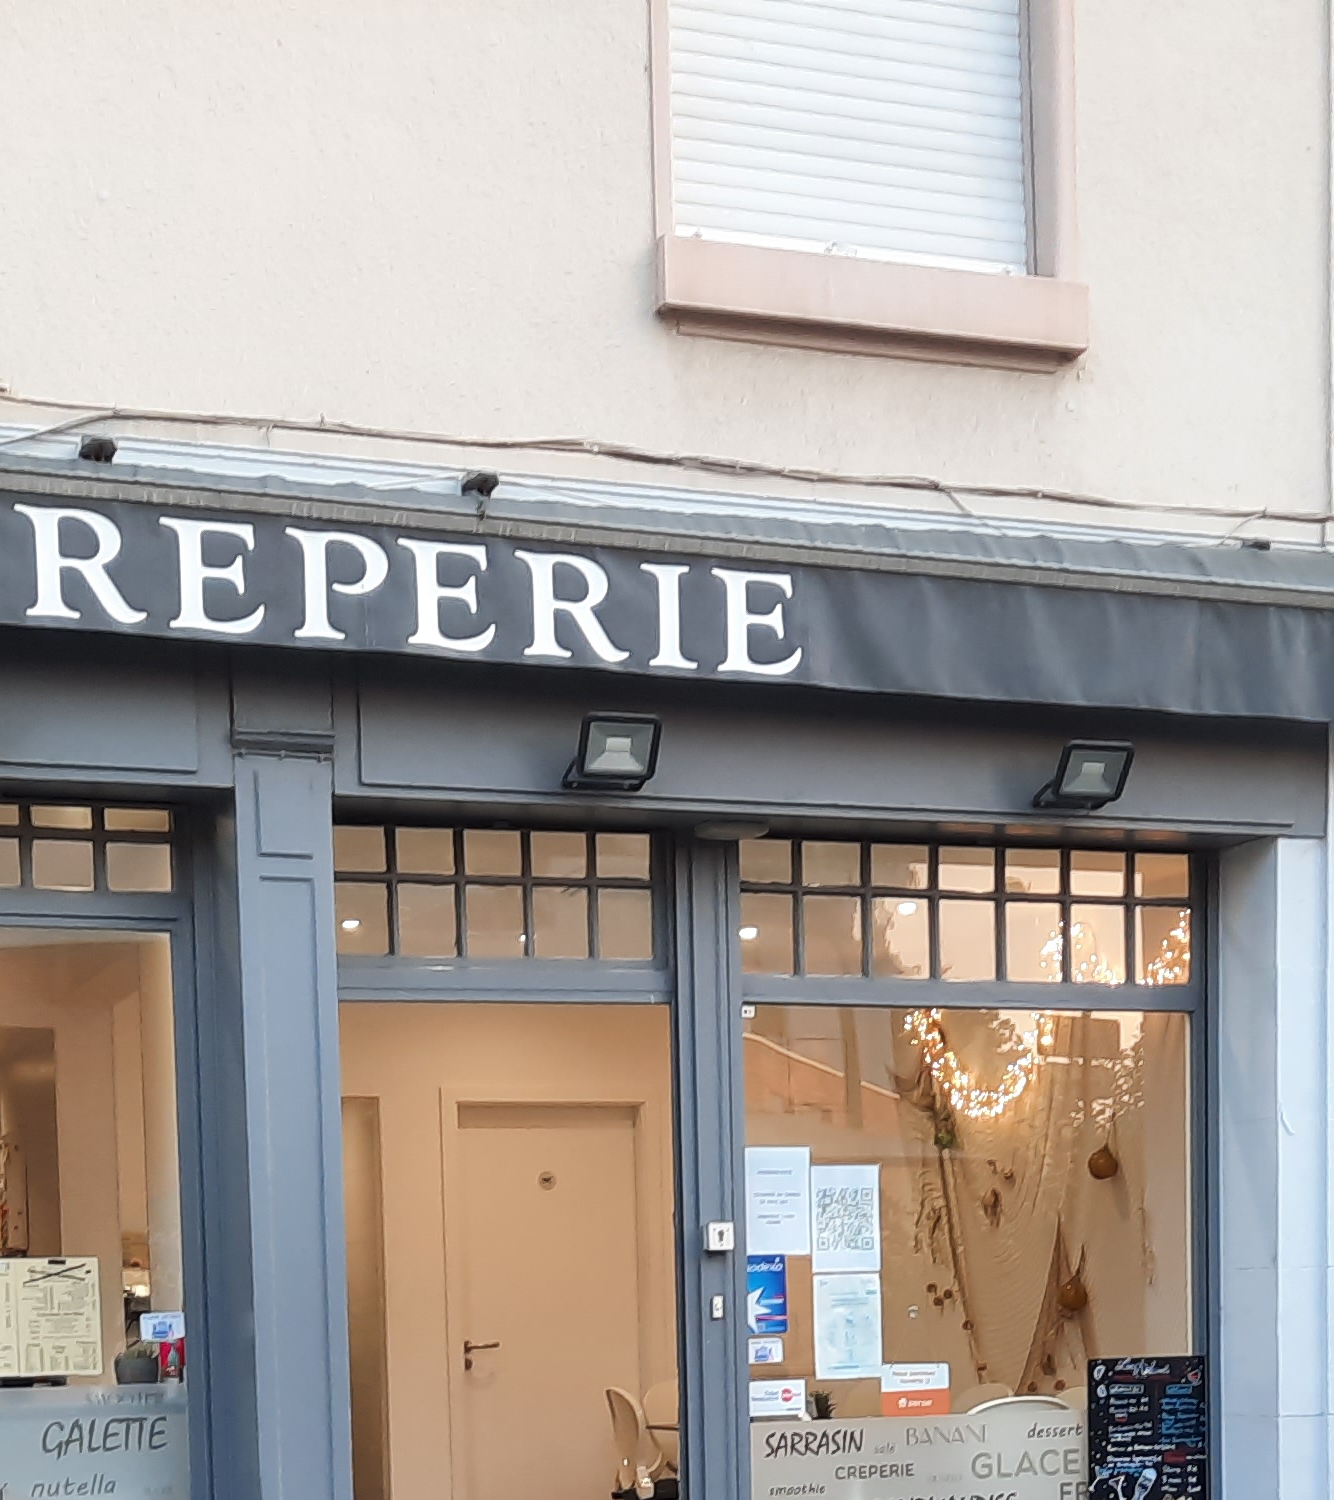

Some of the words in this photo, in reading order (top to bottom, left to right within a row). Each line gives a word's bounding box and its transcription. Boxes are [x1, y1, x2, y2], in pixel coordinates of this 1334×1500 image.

[42, 1416, 168, 1460] GALETTE
[764, 1427, 865, 1459] SARRASIN
[1027, 1421, 1083, 1440] dessert
[835, 1462, 915, 1481] CREPERIE
[971, 1448, 1081, 1480] GLACE
[30, 1473, 117, 1499] nutella
